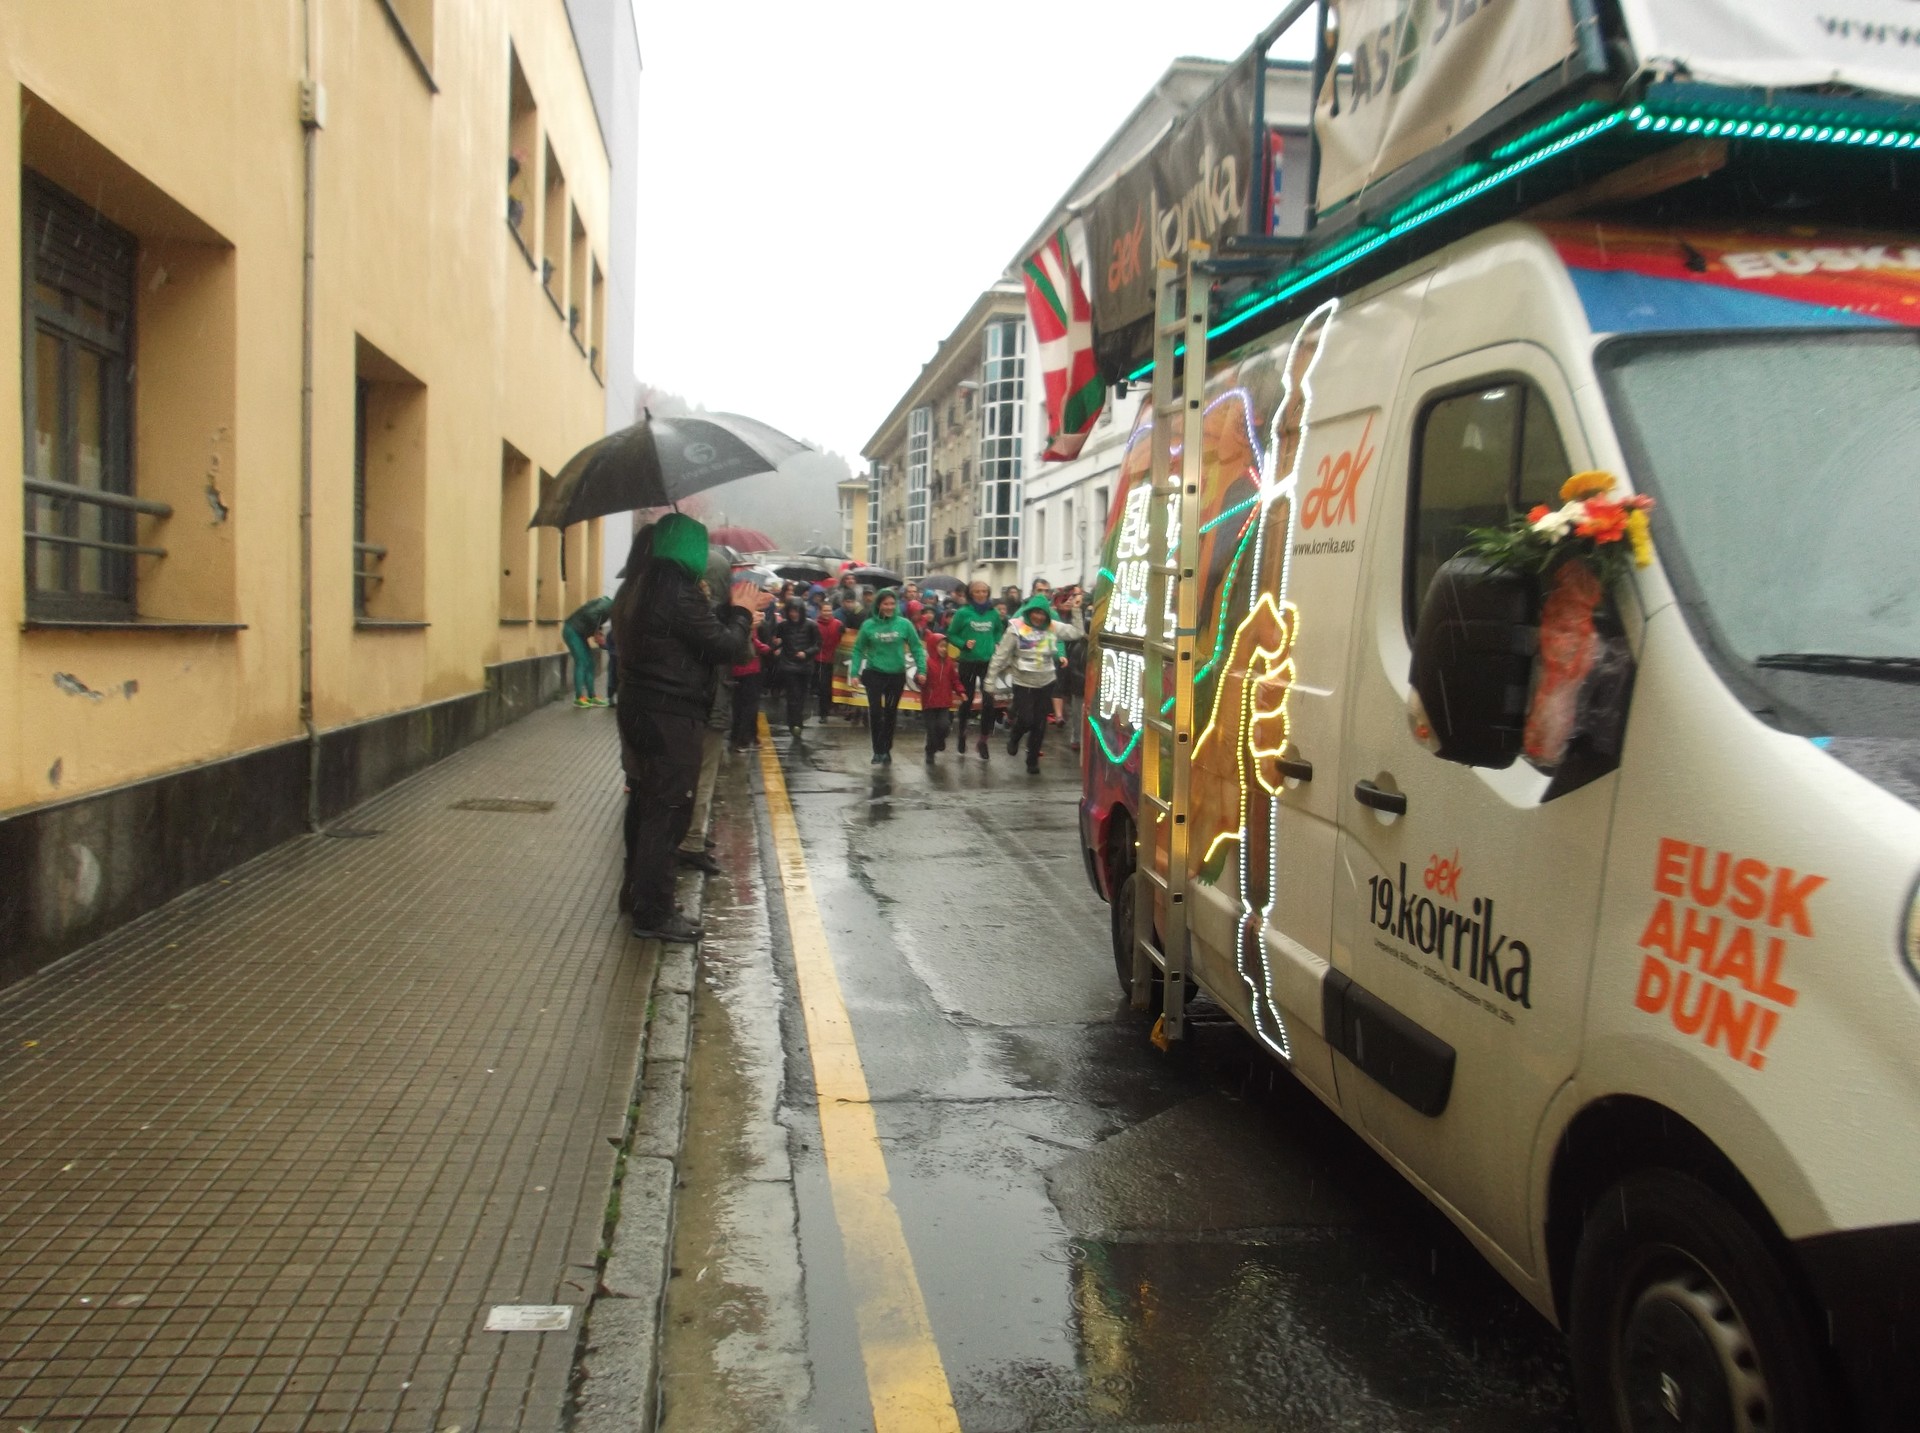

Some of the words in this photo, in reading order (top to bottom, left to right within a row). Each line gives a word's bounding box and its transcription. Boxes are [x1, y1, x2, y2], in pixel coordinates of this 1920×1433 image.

[1108, 203, 1146, 293] aek
[1301, 412, 1376, 530] aek
[1292, 537, 1356, 556] www.korrika.eus
[1423, 847, 1463, 903] aek
[1653, 837, 1829, 938] EUSK
[1637, 898, 1798, 1007] AHAL
[1634, 953, 1780, 1072] DUN!
